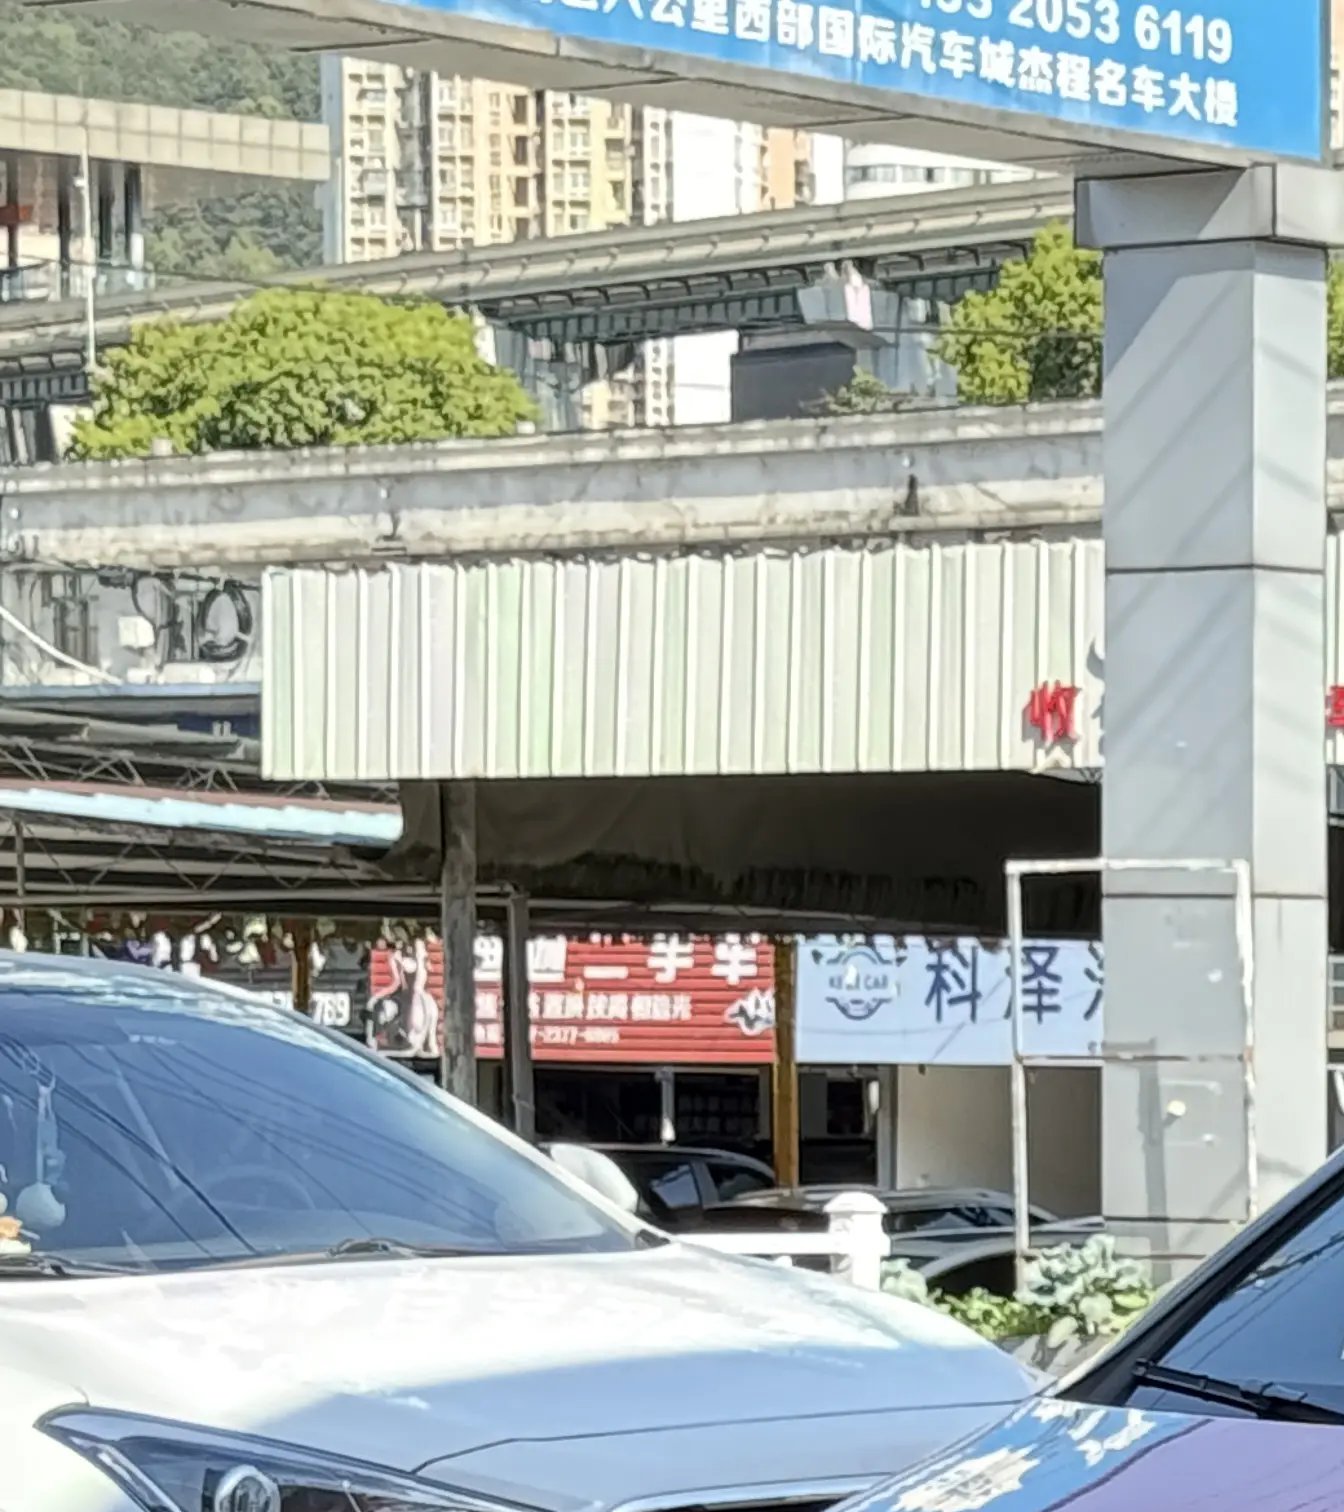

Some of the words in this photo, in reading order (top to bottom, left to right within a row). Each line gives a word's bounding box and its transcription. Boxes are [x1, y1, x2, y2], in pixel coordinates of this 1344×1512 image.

[539, 0, 1238, 128] 八公里西部国际汽车城杰程名车大楼
[1008, 0, 1121, 46] 2053
[1134, 6, 1233, 65] 6119
[924, 944, 1104, 1024] 科泽
